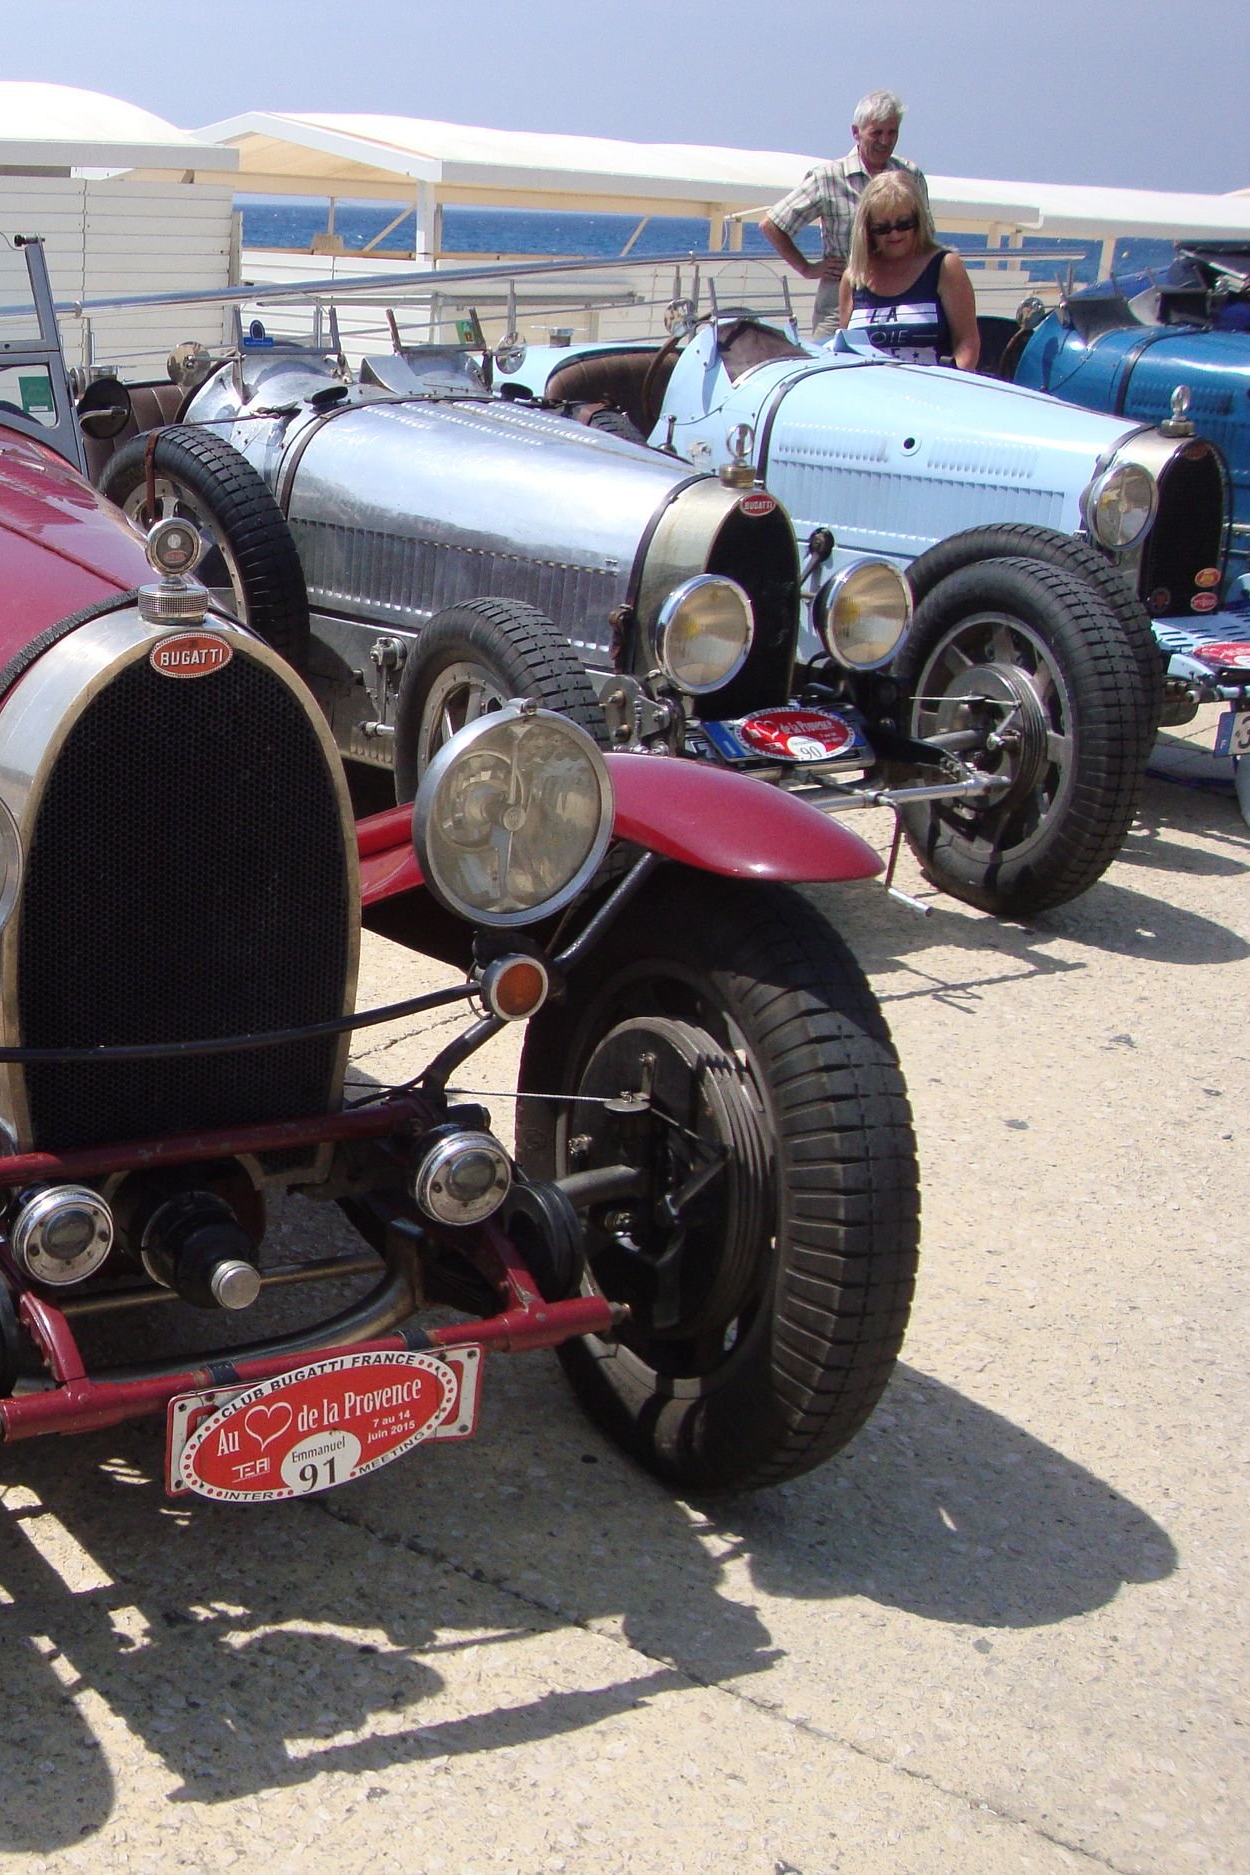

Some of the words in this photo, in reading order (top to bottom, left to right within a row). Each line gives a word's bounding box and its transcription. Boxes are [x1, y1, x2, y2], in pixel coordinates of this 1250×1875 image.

[870, 306, 898, 324] LA
[870, 329, 909, 344] OIE
[744, 501, 773, 510] BUGATTI
[160, 648, 223, 667] BUGATTI
[800, 746, 822, 758] 90
[1220, 739, 1228, 750] F
[221, 1388, 265, 1419] CLUB
[270, 1357, 345, 1391] BUGATTI
[351, 1353, 416, 1368] FRANCE
[216, 1428, 240, 1457] Au
[297, 1404, 320, 1433] de
[323, 1398, 340, 1426] la
[344, 1378, 422, 1419] Provence
[372, 1418, 379, 1428] 7
[381, 1415, 395, 1426] au
[397, 1410, 411, 1421] 14
[389, 1420, 416, 1437] 2015
[291, 1435, 347, 1463] Emmanuel
[358, 1432, 425, 1474] MEETING
[298, 1455, 337, 1492] 91
[223, 1490, 274, 1501] INTER
